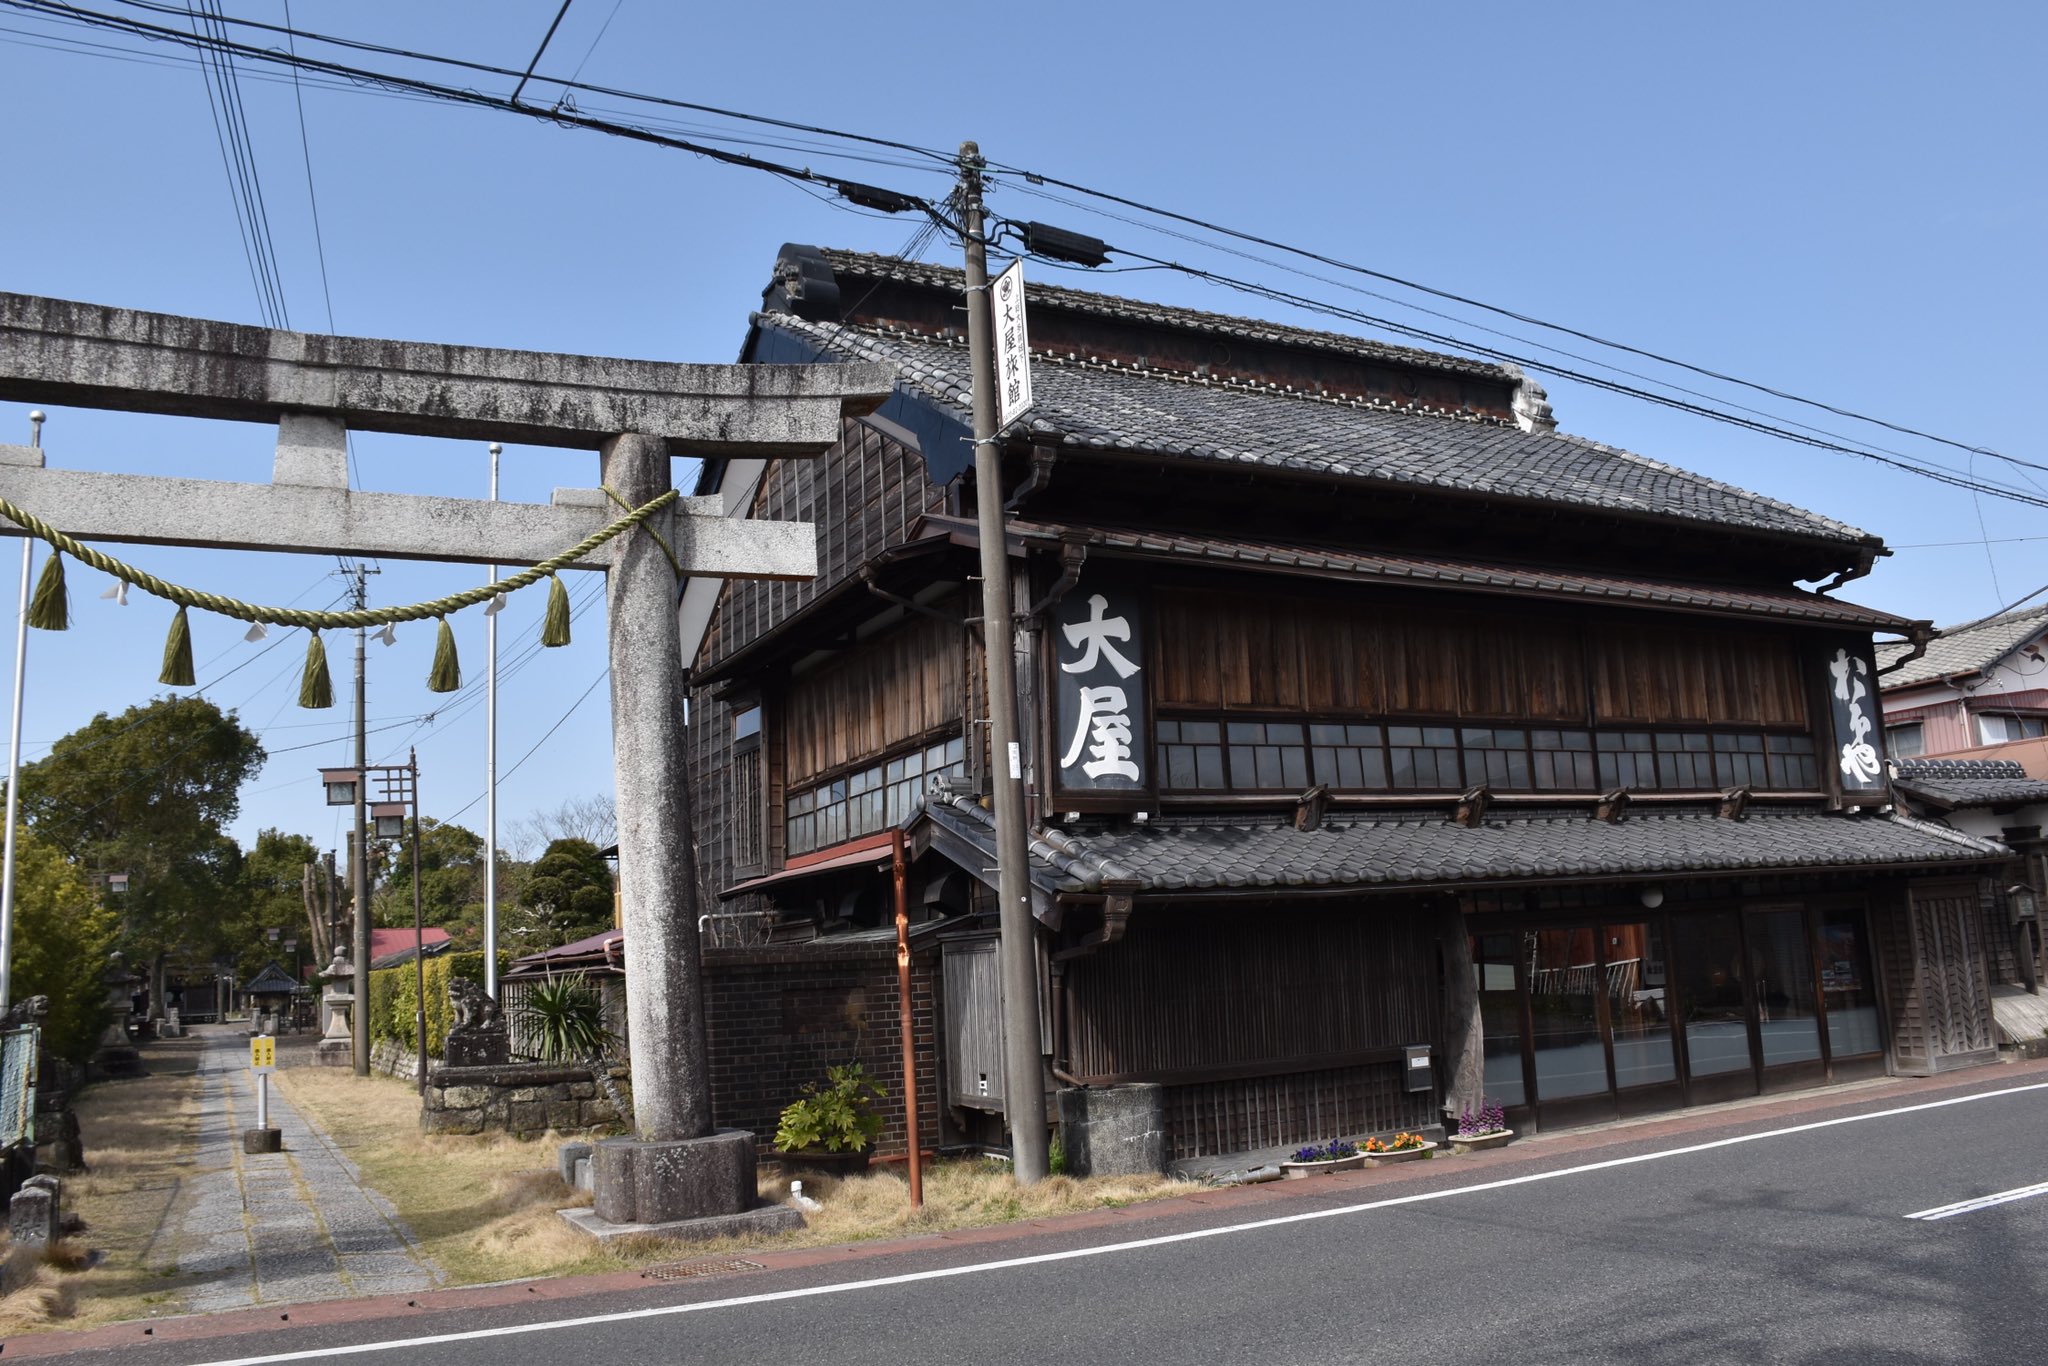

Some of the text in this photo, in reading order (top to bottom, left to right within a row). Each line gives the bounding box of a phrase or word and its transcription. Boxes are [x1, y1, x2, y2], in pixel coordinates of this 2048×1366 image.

[1003, 303, 1021, 407] 大屋旅館
[1060, 594, 1142, 782] 大屋
